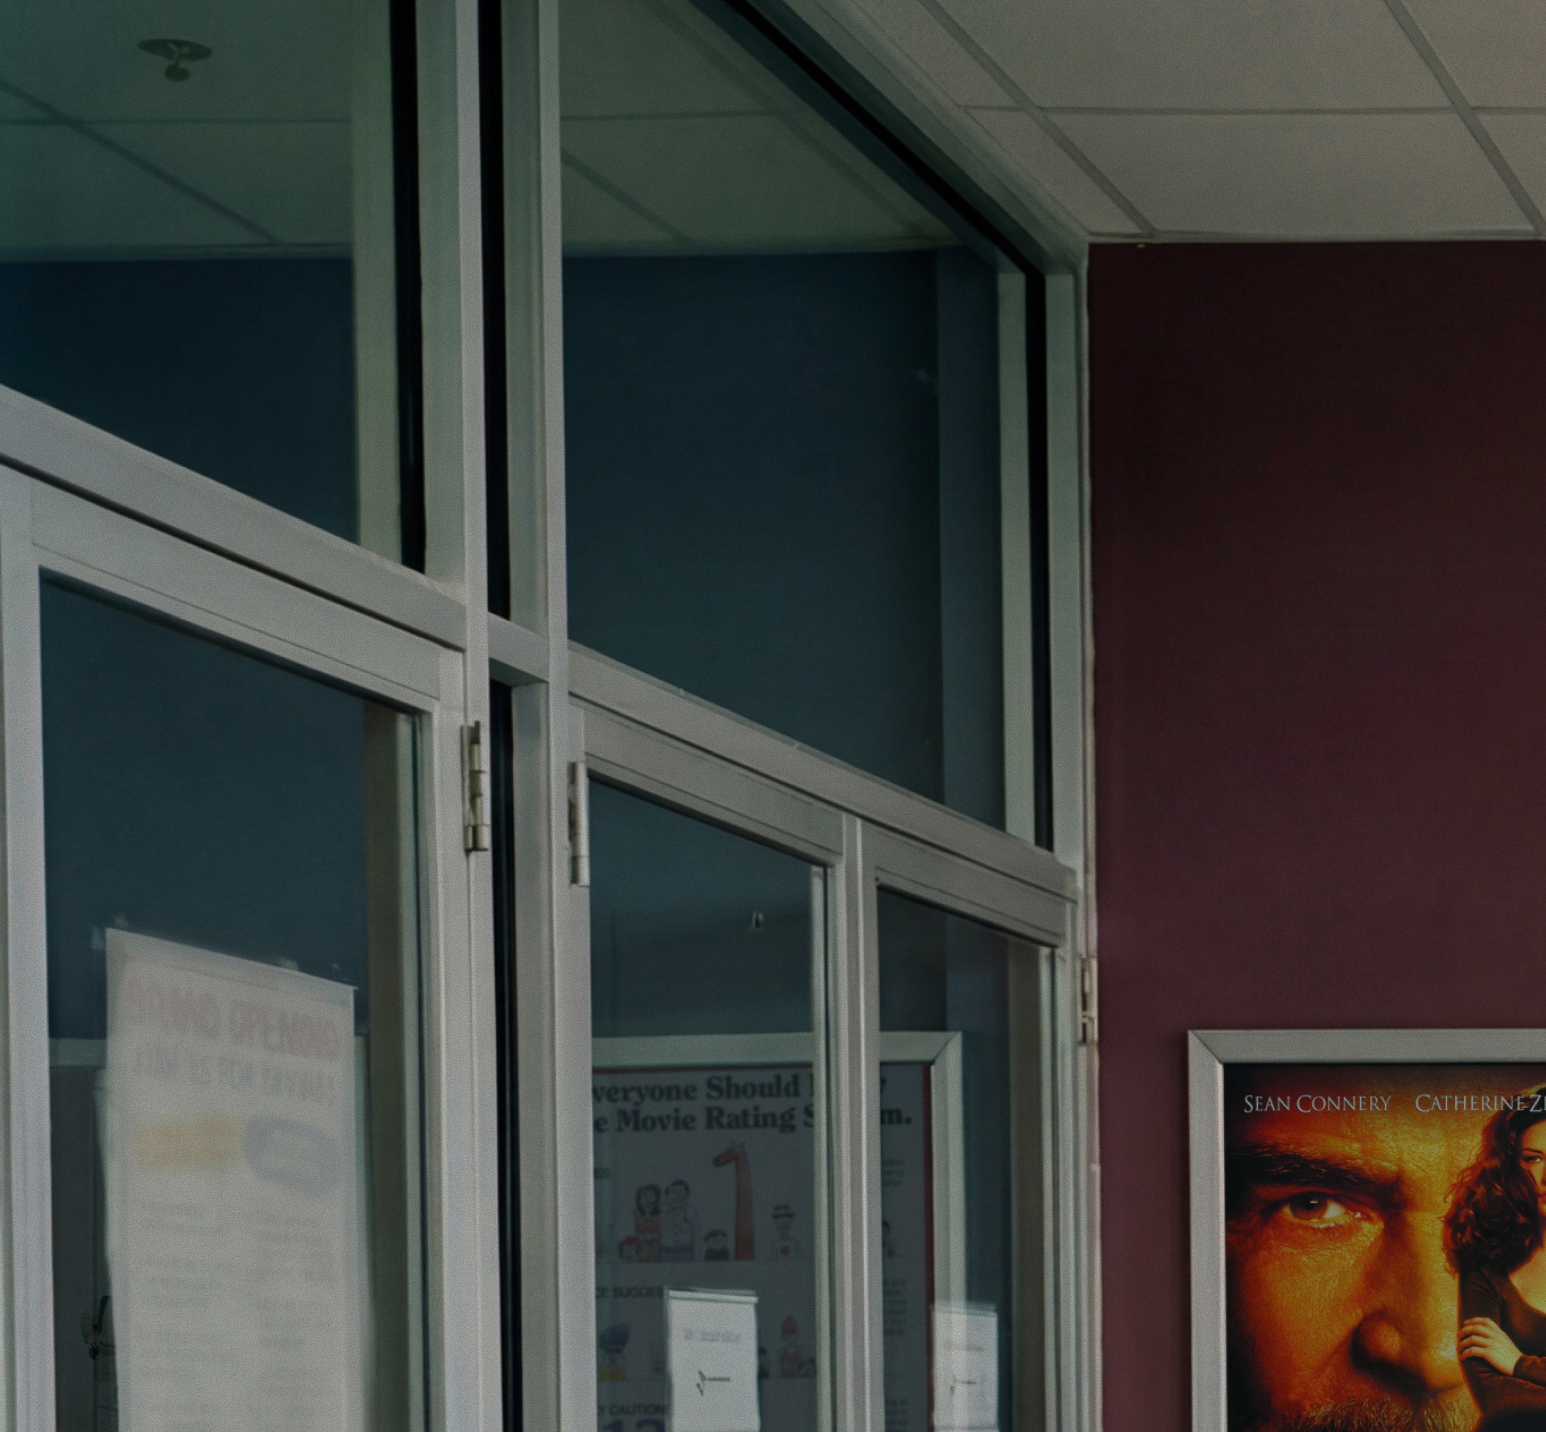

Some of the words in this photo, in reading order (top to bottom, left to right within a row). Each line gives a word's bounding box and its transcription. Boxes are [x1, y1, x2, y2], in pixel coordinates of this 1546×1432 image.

[592, 1081, 697, 1105] veryone
[706, 1075, 800, 1100] Should
[1244, 1094, 1291, 1113] SEAN
[1296, 1094, 1391, 1113] CONNERY
[1415, 1094, 1525, 1112] CATHERINE
[616, 1108, 696, 1131] Movie
[705, 1106, 797, 1133] Rating
[612, 1287, 663, 1298] SUGGES
[609, 1405, 667, 1415] CAUTION
